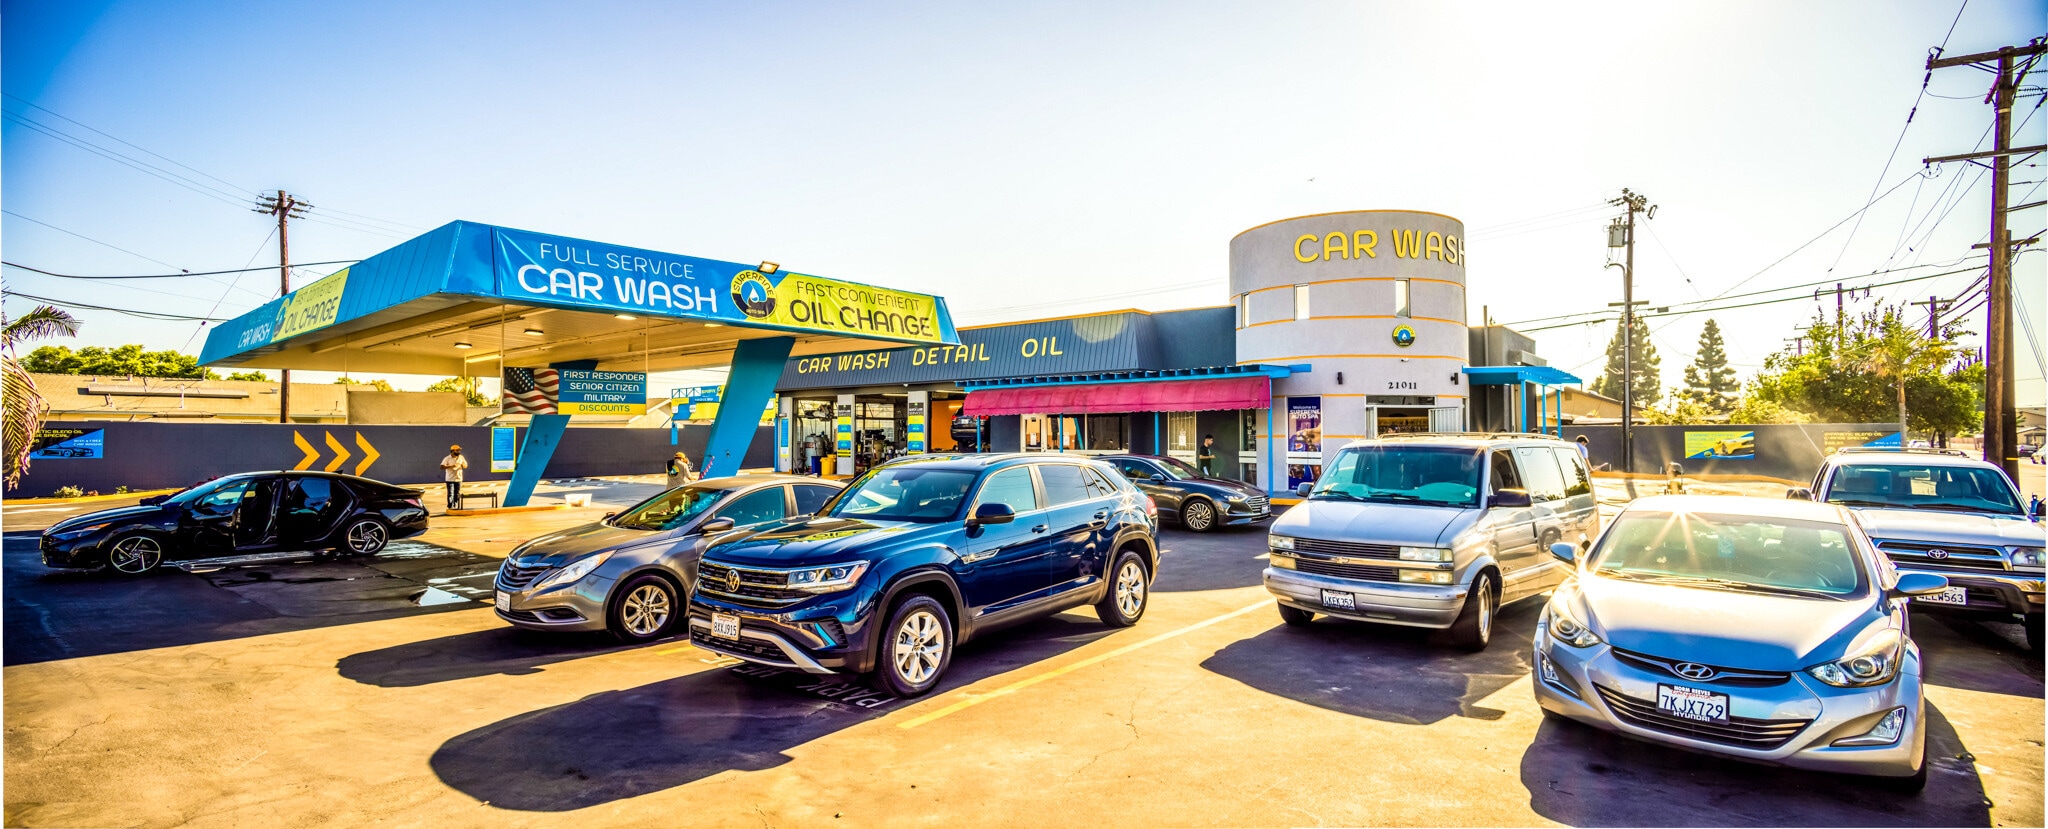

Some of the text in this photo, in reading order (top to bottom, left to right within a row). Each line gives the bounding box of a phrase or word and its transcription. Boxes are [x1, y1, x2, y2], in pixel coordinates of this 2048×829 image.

[1293, 228, 1465, 268] CAR WASH
[540, 242, 696, 280] FULL SERVICE
[517, 263, 718, 313] CAR WASH
[733, 271, 774, 296] SUPERFINE
[797, 280, 920, 311] FAST CONVENIENT
[284, 311, 299, 334] OIL
[298, 296, 339, 330] CHANGE
[789, 299, 934, 337] OIL CHANGE
[250, 321, 273, 345] WASH
[798, 336, 1063, 374] CAR WASH DETAIL OIL
[563, 370, 645, 381] FIRST RESPONDER
[569, 382, 640, 392] SENIOR CITIZEN
[1388, 381, 1417, 389] 21011
[578, 404, 630, 412] DISCOUNTS
[583, 393, 626, 402] MILITARY
[1661, 694, 1724, 719] 7KJX729
[1673, 711, 1711, 722] HYUNDAI
